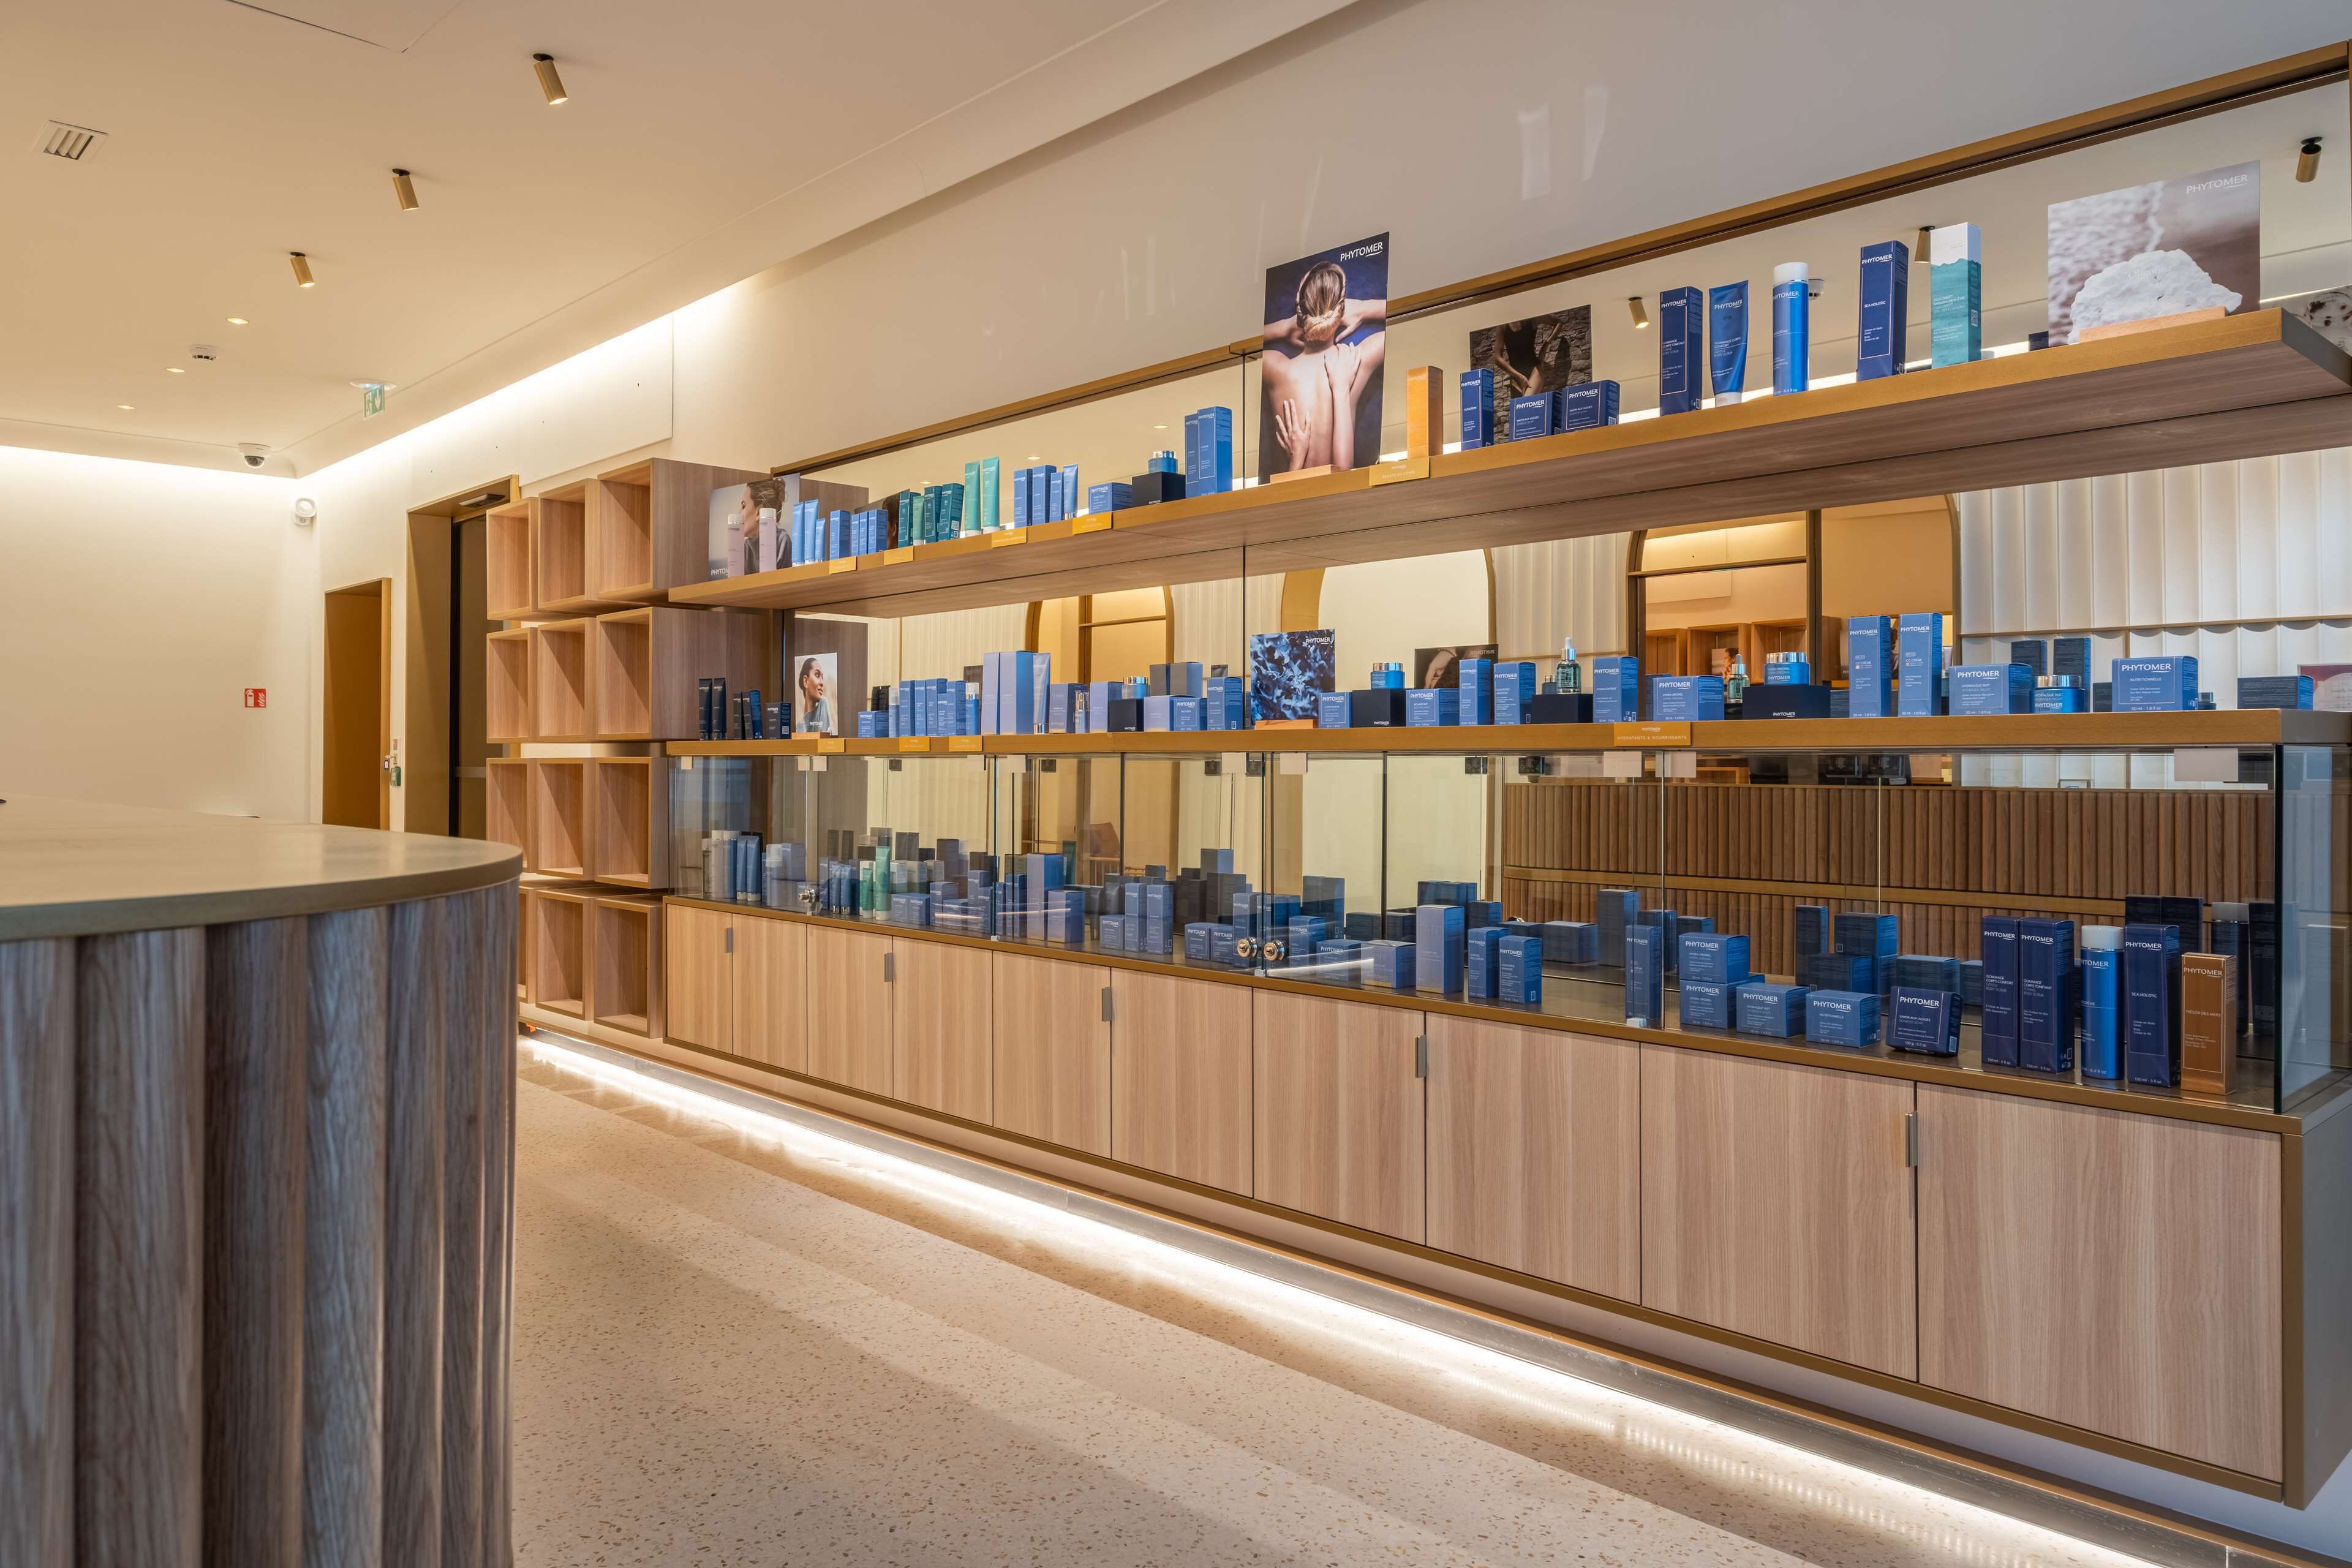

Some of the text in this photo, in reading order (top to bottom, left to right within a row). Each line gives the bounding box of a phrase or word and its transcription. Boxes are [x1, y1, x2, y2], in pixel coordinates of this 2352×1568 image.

[2186, 175, 2249, 194] PHYTOMER
[1340, 242, 1384, 262] PHYTOMER
[1862, 254, 1893, 265] PHYTOMER
[1773, 291, 1800, 301] HYTOMER
[1661, 299, 1687, 309] PHYTOMER
[1714, 299, 1744, 309] PHYTOMER
[1569, 388, 1598, 399] PHYTOMER
[1517, 399, 1545, 410] PHYTOMER
[2122, 663, 2172, 672] PHYTOMER
[1984, 930, 2016, 939] PHYTOMER
[2021, 935, 2054, 943] PHYTOMER
[1686, 941, 1719, 949] PHYTOMER
[2081, 959, 2109, 967] YTOMER
[2183, 967, 2223, 976] PHYTOMER
[1686, 985, 1720, 994] PHYTOMER
[1743, 993, 1779, 1003] PHYTOMER
[1900, 996, 1940, 1007] PHYTOMER
[1813, 1000, 1852, 1010] PHYTOMER
